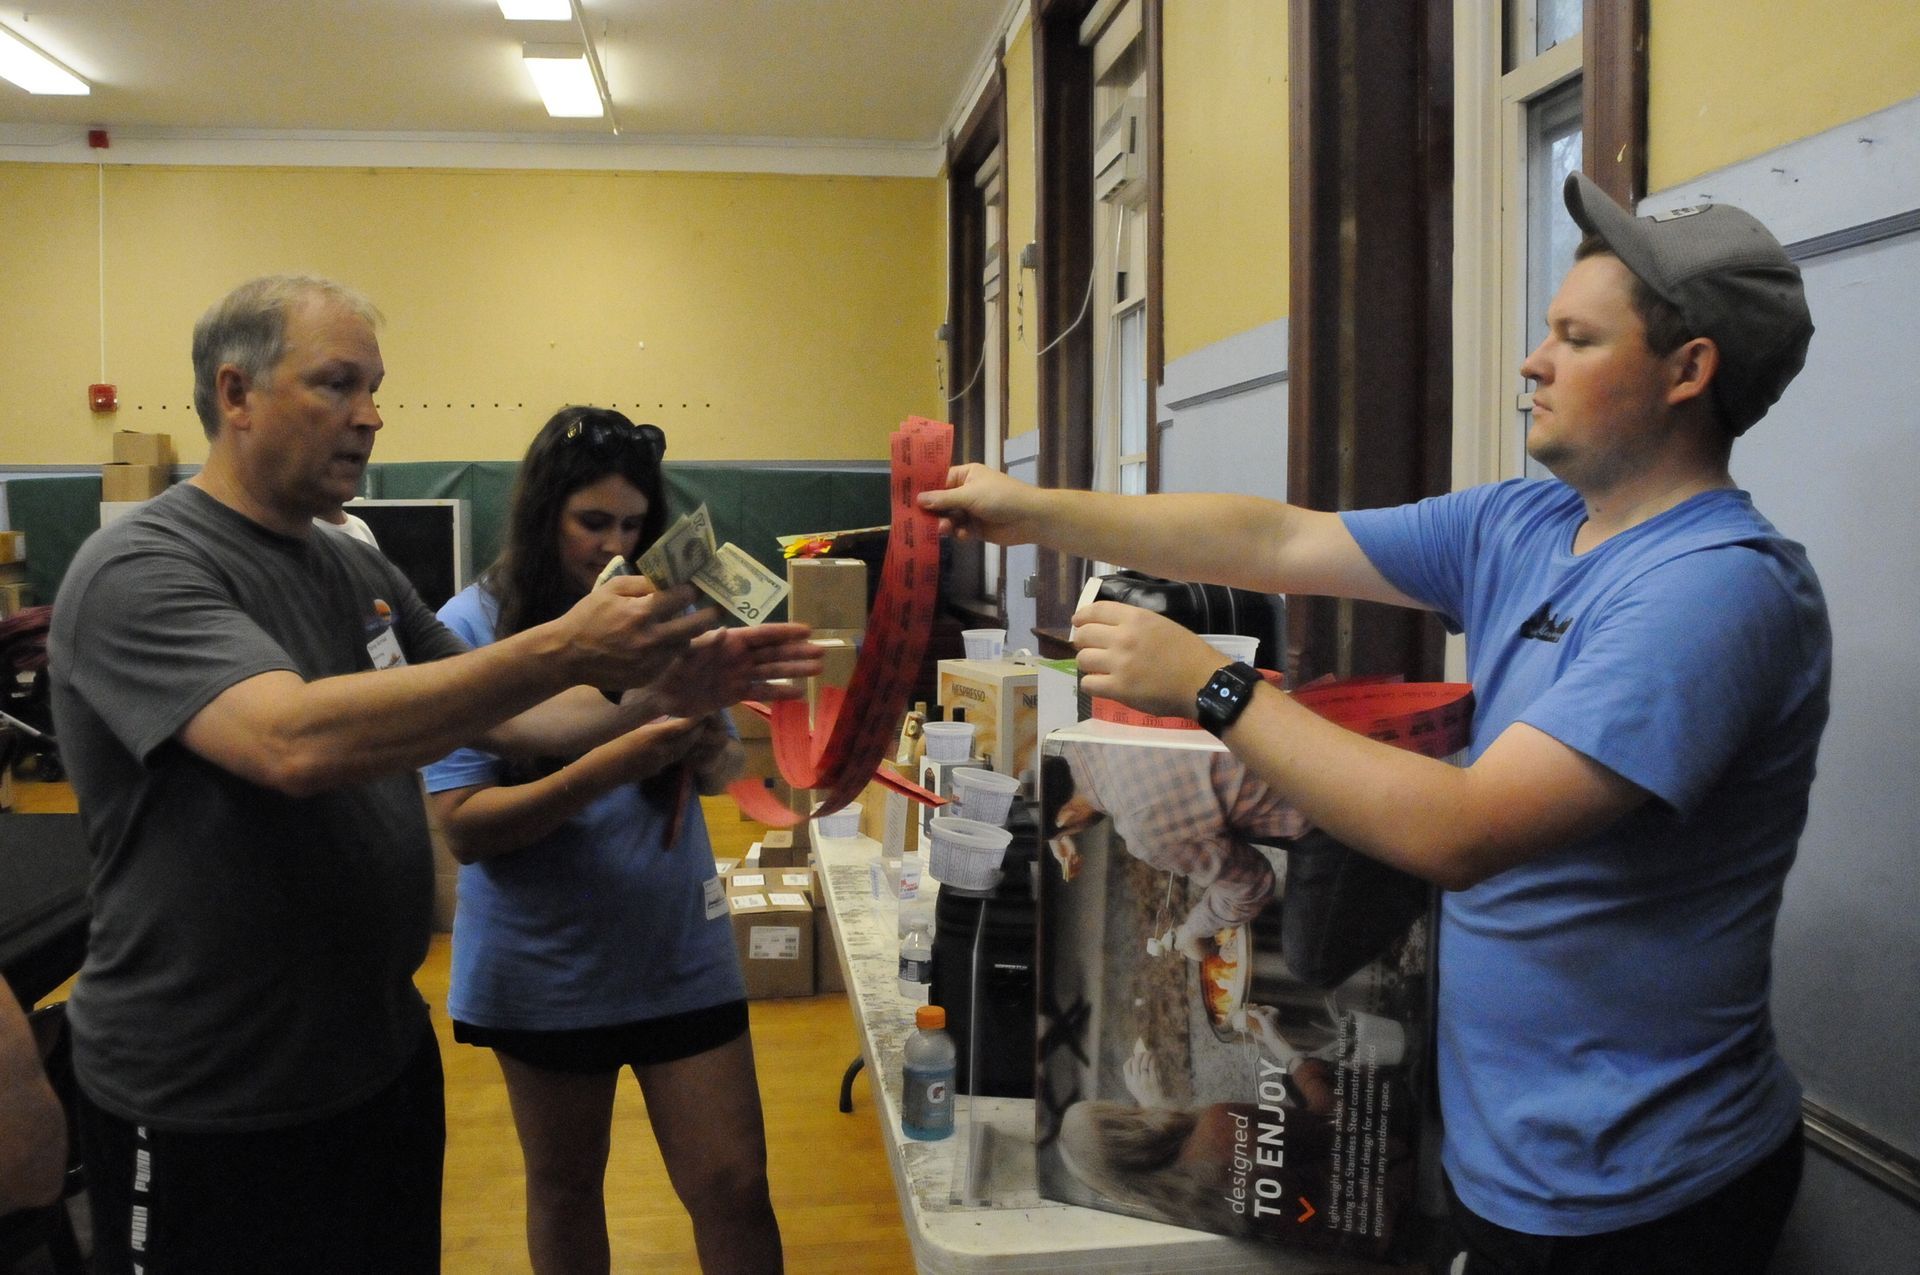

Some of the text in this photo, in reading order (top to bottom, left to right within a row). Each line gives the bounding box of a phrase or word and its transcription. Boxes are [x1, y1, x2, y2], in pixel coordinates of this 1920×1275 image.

[737, 602, 759, 619] 20
[952, 682, 986, 702] NESPRESSO
[1350, 1044, 1361, 1105] construction
[1254, 1057, 1286, 1217] TO ENJOY
[1328, 1016, 1347, 1229] Lightweight and low smoke. Bonfire features
[1347, 1108, 1357, 1133] Steel
[1358, 1045, 1376, 1234] double-walled design for uninterrupted
[1225, 1112, 1252, 1214] designed
[1345, 1136, 1356, 1178] Stainless
[1374, 1081, 1391, 1237] enjoyment in any outdoor space.
[1343, 1201, 1355, 1231] lasting
